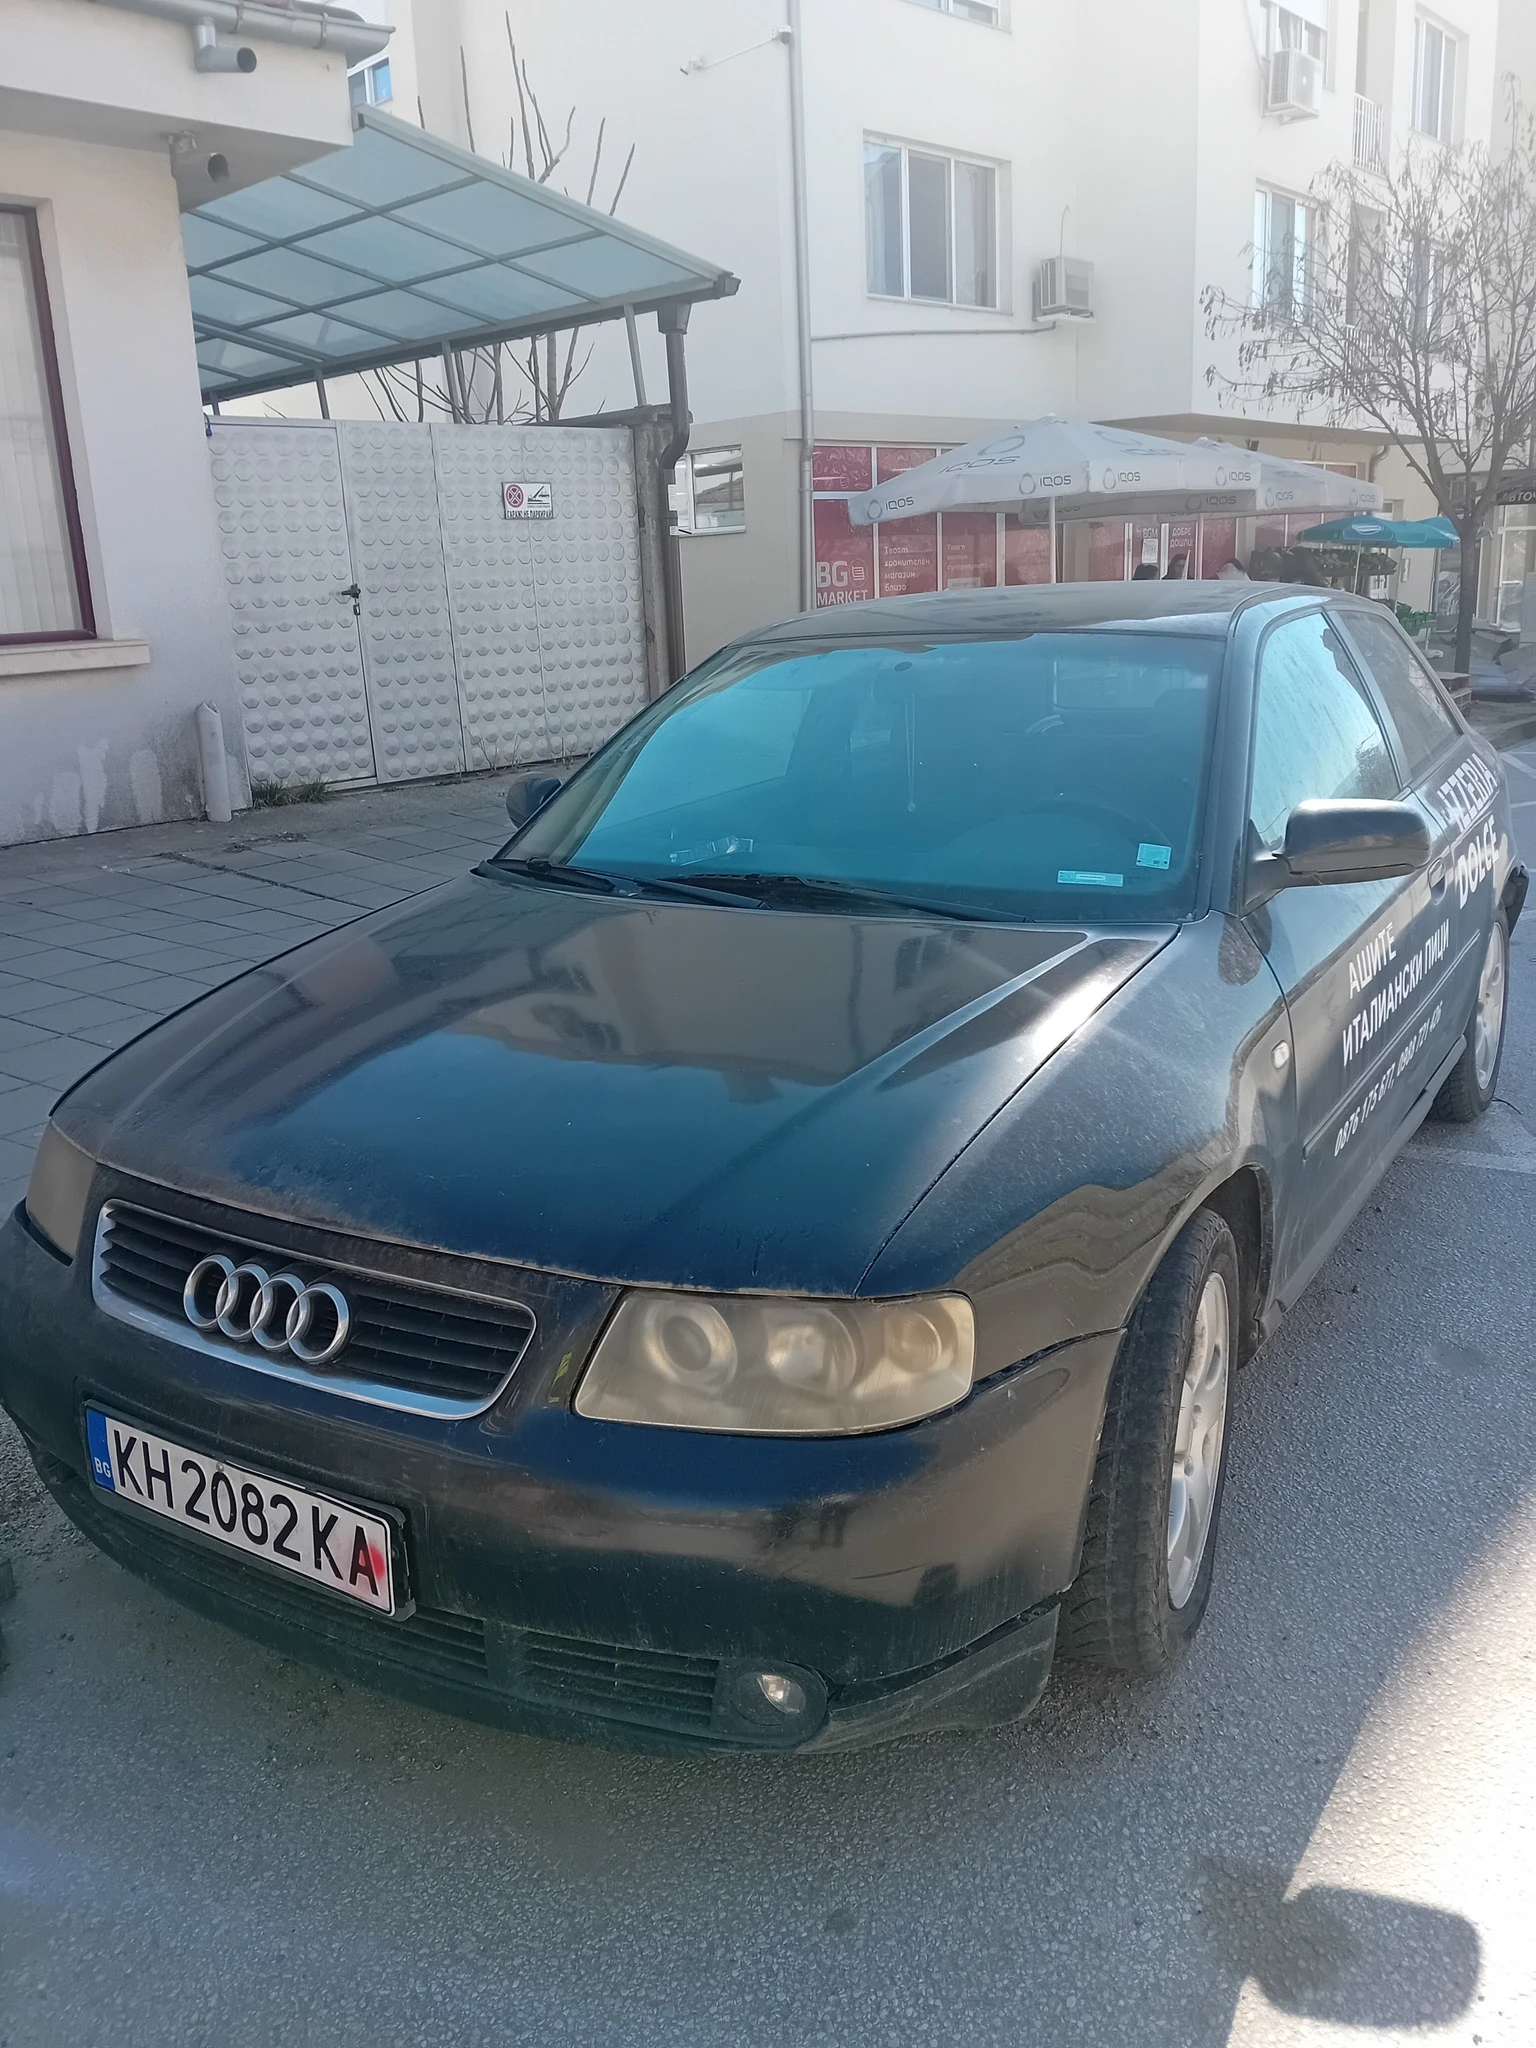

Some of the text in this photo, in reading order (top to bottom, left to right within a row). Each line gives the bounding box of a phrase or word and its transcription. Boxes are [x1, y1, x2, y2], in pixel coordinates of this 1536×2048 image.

[1039, 474, 1072, 487] IQOS
[1117, 471, 1141, 483] IQOS
[1228, 471, 1251, 482] IQOS
[885, 496, 914, 511] IQOS
[816, 560, 848, 588] BG
[884, 572, 916, 580] магазин
[884, 584, 907, 592] близо
[817, 590, 868, 606] MARKET
[1457, 814, 1500, 910] DOLCE
[1342, 918, 1450, 1067] ИТАЛИАНСКИ ПИЦИ
[1334, 1106, 1361, 1157] 0876
[1360, 1082, 1380, 1124] 175
[94, 1456, 112, 1479] BG
[113, 1429, 380, 1597] KH2082KA
